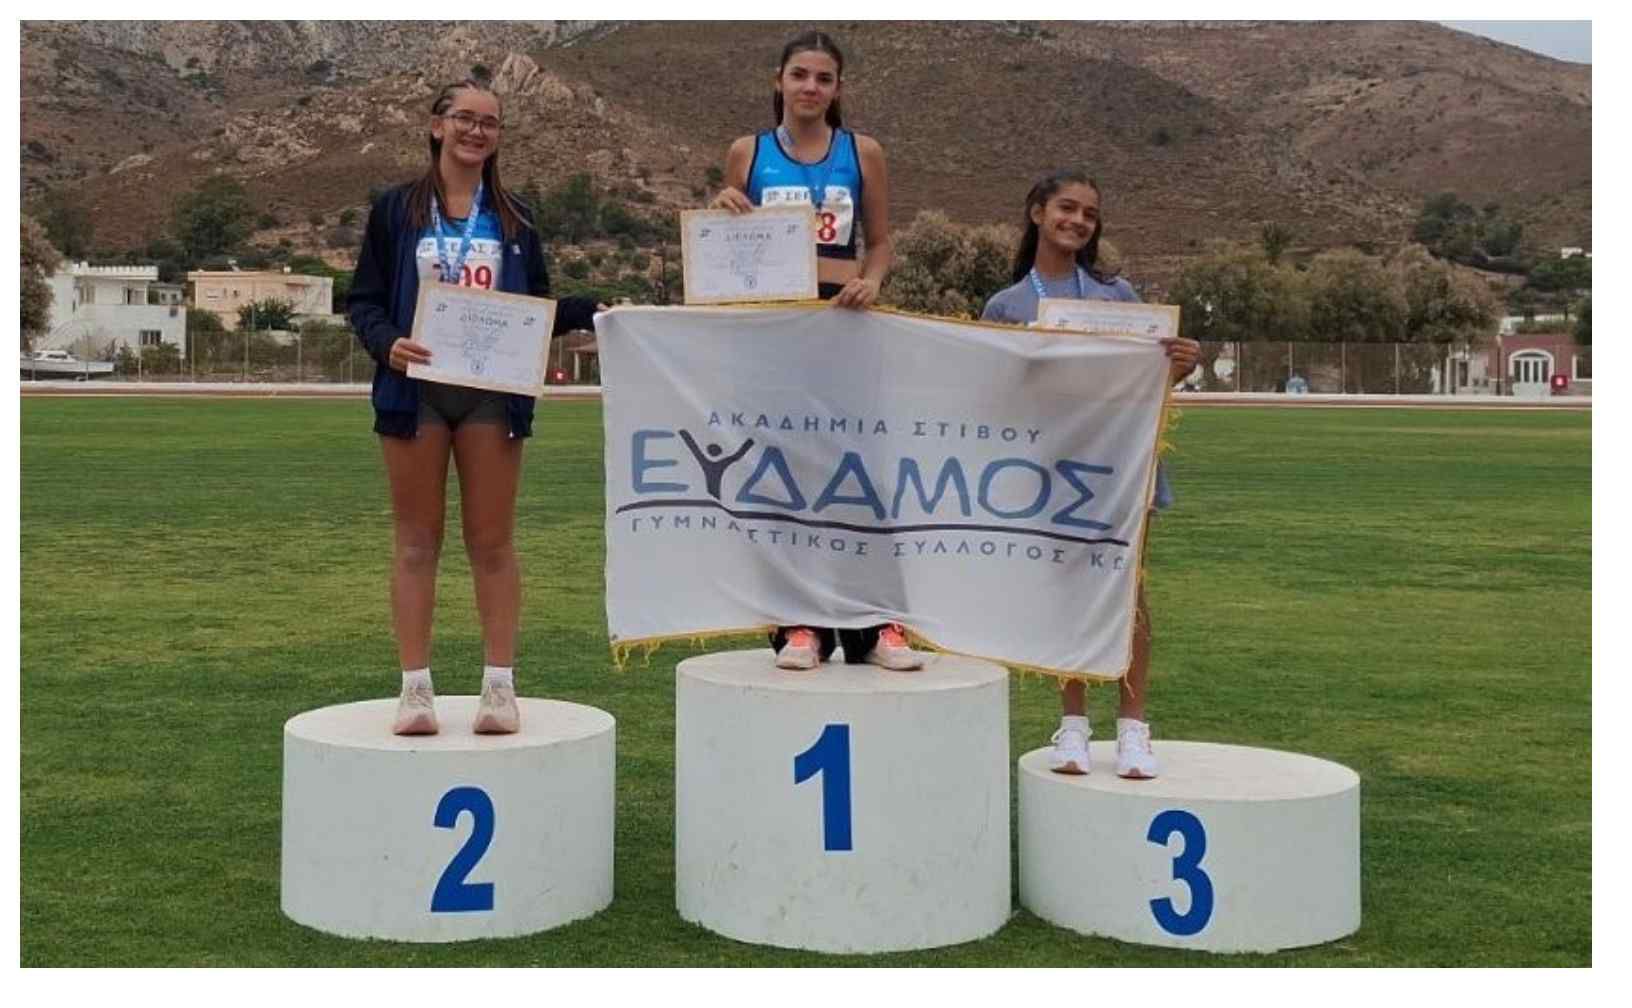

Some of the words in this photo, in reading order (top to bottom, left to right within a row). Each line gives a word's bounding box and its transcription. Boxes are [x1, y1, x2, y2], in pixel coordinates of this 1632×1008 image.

[631, 428, 1114, 531] ΕΥΔΑΜΟΣ
[708, 410, 888, 435] ΑΚΑΔΗΜΙΑ
[913, 421, 1042, 444] ΣΤΙΒΟΥ
[894, 540, 1066, 564] ΣΥΛΛΟΓΟΣ
[793, 723, 853, 852] 1
[431, 786, 496, 914] 2
[1147, 809, 1216, 937] 3
